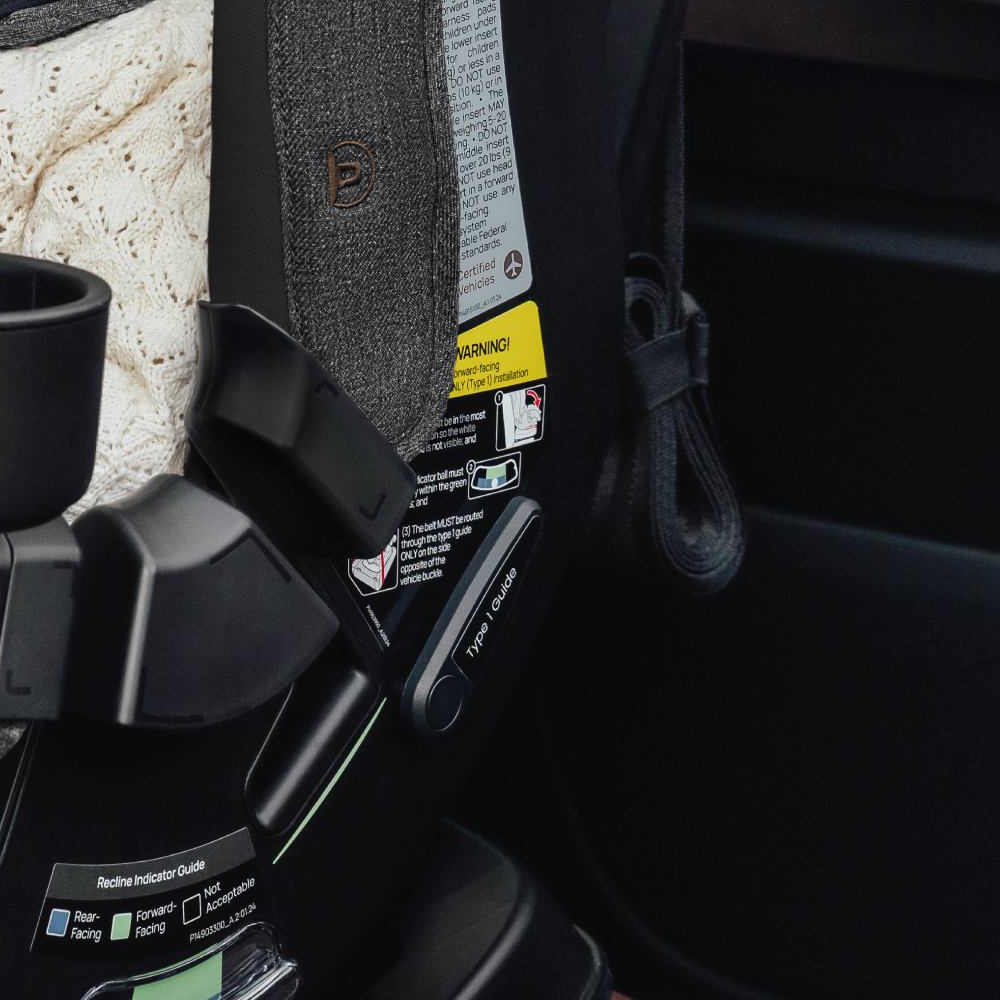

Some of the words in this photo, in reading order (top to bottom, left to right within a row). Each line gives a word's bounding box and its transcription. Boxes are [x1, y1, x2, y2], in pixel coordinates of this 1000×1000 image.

[478, 3, 496, 19] pads
[474, 16, 497, 30] under
[451, 37, 472, 50] lower
[475, 27, 498, 42] insert
[447, 54, 458, 64] for
[467, 40, 499, 58] children
[458, 64, 466, 73] or
[468, 57, 484, 70] less
[486, 54, 493, 63] in
[466, 69, 483, 83] NOT
[486, 64, 500, 75] use
[459, 88, 469, 100] (10
[471, 81, 483, 95] kg)
[486, 80, 493, 88] or
[495, 76, 502, 85] in
[488, 89, 503, 100] The
[463, 107, 486, 121] insert
[488, 98, 504, 113] MAY
[488, 111, 506, 125] 5-20
[478, 129, 490, 141] DO
[491, 122, 508, 136] NOT
[486, 136, 509, 151] insert
[460, 161, 477, 173] over
[478, 155, 488, 167] 20
[490, 152, 501, 162] lbs
[503, 146, 511, 159] (9
[477, 168, 491, 179] use
[493, 158, 512, 173] head
[468, 186, 476, 195] in
[484, 172, 513, 189] forward
[463, 195, 480, 209] NOT
[483, 190, 498, 202] use
[502, 184, 515, 195] any
[460, 219, 487, 237] system
[479, 222, 507, 241] Federal
[461, 238, 502, 260] standards.
[466, 378, 486, 391] (Type
[487, 374, 492, 386] 1)
[493, 368, 529, 383] Installation
[453, 415, 459, 424] in
[459, 413, 470, 423] the
[470, 409, 486, 420] most
[440, 430, 447, 439] so
[447, 427, 459, 437] the
[459, 423, 476, 434] white
[432, 441, 443, 451] not
[464, 434, 477, 445] and
[437, 469, 448, 481] ball
[449, 467, 465, 478] must
[418, 483, 438, 495] within
[439, 480, 449, 490] the
[449, 478, 467, 491] green
[416, 496, 428, 507] and
[401, 523, 411, 538] (3)
[412, 523, 424, 535] The
[424, 520, 436, 532] belt
[436, 516, 455, 529] MUST
[455, 513, 464, 525] be
[464, 509, 483, 523] routed
[401, 536, 426, 549] through
[426, 533, 438, 543] the
[438, 530, 451, 544] type
[455, 525, 472, 539] guide
[400, 548, 418, 561] ONLY
[418, 548, 426, 557] on
[427, 545, 437, 555] the
[438, 542, 451, 553] side
[400, 561, 428, 574] opposite
[428, 559, 435, 568] of
[435, 556, 446, 566] the
[400, 573, 422, 586] vehicle
[422, 569, 443, 582] buckle.
[466, 622, 489, 657] Type
[486, 612, 493, 620] 1
[491, 568, 517, 611] Guide
[97, 875, 132, 889] Recline
[134, 869, 177, 886] Indicator
[177, 860, 206, 877] Guide
[203, 881, 221, 899] Not
[206, 877, 255, 914] Acceptable
[74, 910, 100, 923] Rear-
[136, 901, 178, 923] Forward-
[70, 927, 102, 943] Facing
[135, 921, 166, 939] Facing
